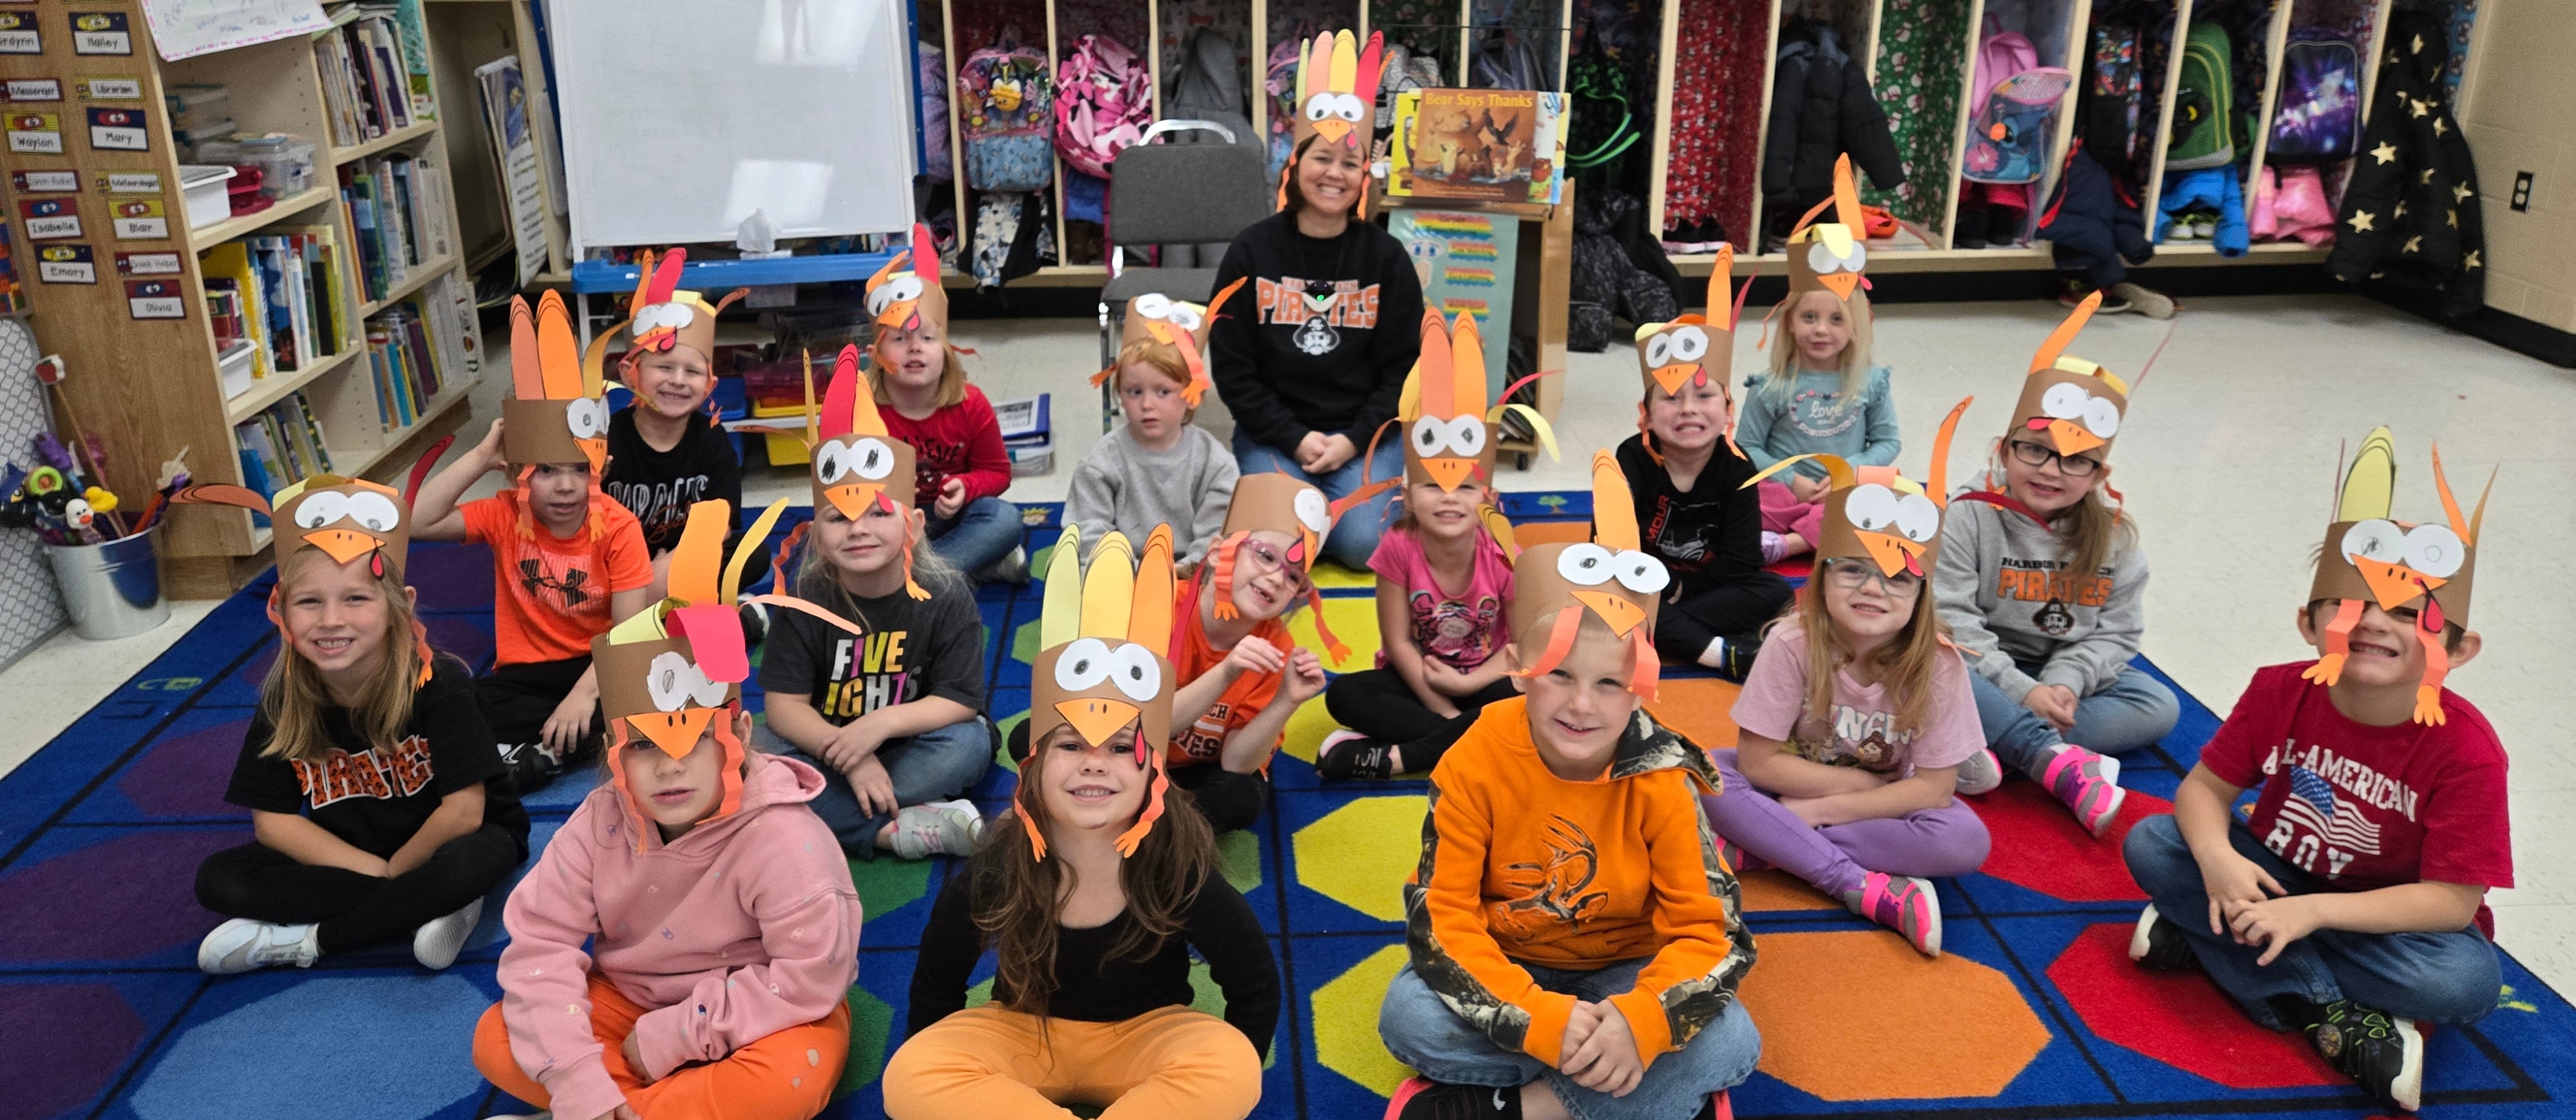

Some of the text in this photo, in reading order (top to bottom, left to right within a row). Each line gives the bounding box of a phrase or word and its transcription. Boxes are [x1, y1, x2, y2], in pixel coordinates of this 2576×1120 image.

[1425, 92, 1453, 106] Bear
[1456, 93, 1484, 109] Says
[1488, 93, 1533, 108] Thanks
[105, 132, 133, 145] Mary
[1808, 399, 1843, 419] love
[1998, 567, 2114, 607] PIRATES
[831, 631, 907, 681] FIVE
[821, 665, 922, 717] IGHTS
[2264, 818, 2354, 881] BOY
